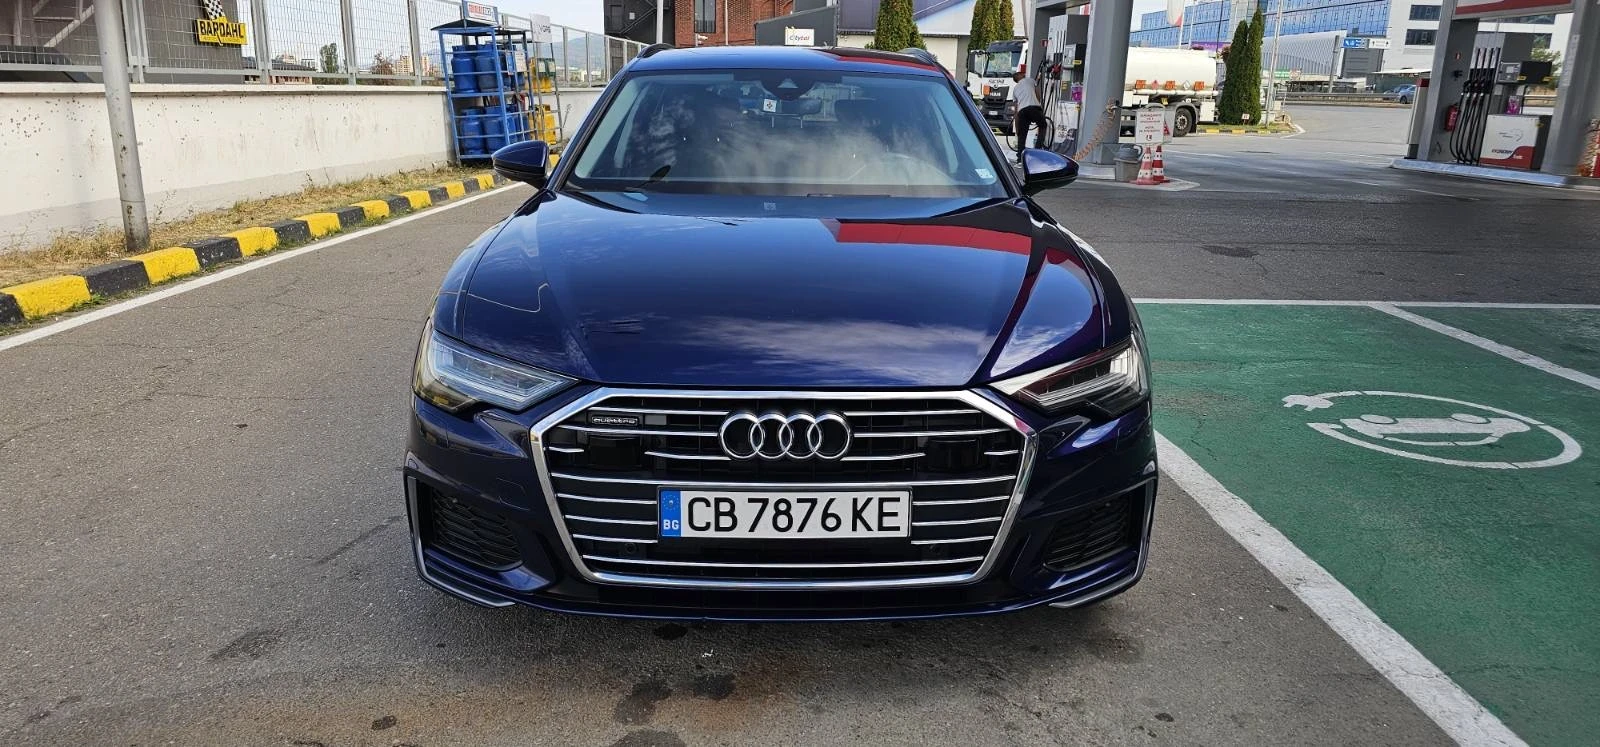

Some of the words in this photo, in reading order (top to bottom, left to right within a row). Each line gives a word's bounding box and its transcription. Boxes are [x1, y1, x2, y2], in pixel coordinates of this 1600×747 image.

[663, 519, 680, 530] BG
[687, 496, 738, 533] CB
[747, 497, 842, 533] 7876
[851, 497, 901, 532] KE
